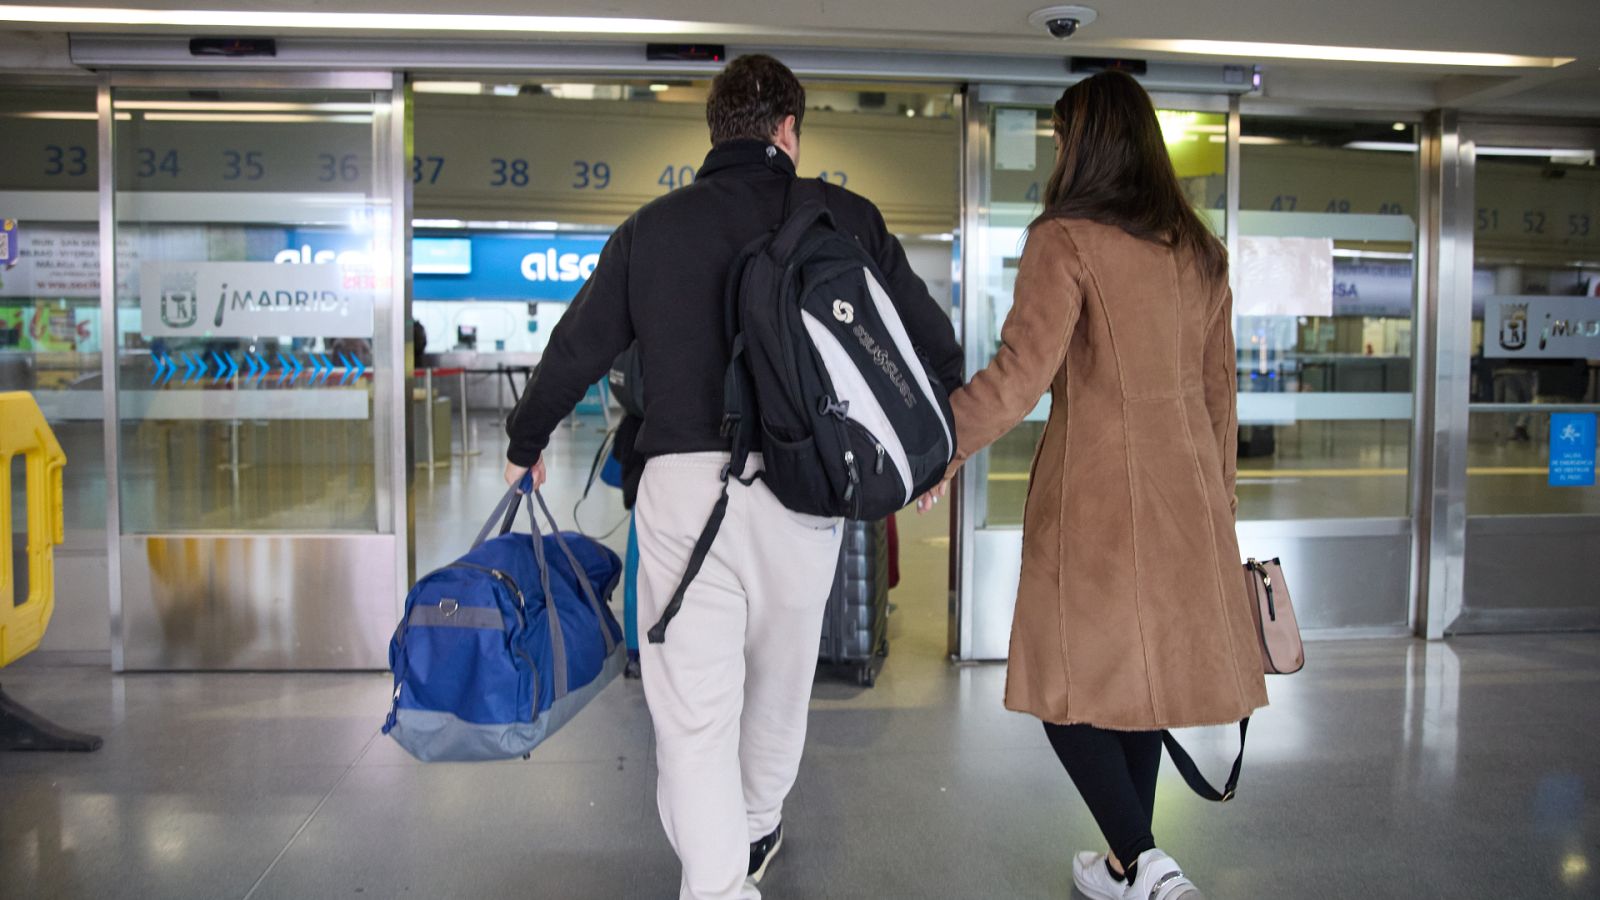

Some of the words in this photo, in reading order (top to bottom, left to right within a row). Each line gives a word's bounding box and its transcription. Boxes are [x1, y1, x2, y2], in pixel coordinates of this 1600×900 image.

[44, 146, 88, 176] 33
[137, 149, 181, 178] 34
[223, 151, 265, 181] 35
[319, 154, 361, 182] 36
[490, 159, 529, 187] 38
[572, 162, 611, 189] 39
[1477, 208, 1499, 231] 51
[1522, 210, 1546, 234] 52
[1567, 213, 1591, 237] 53
